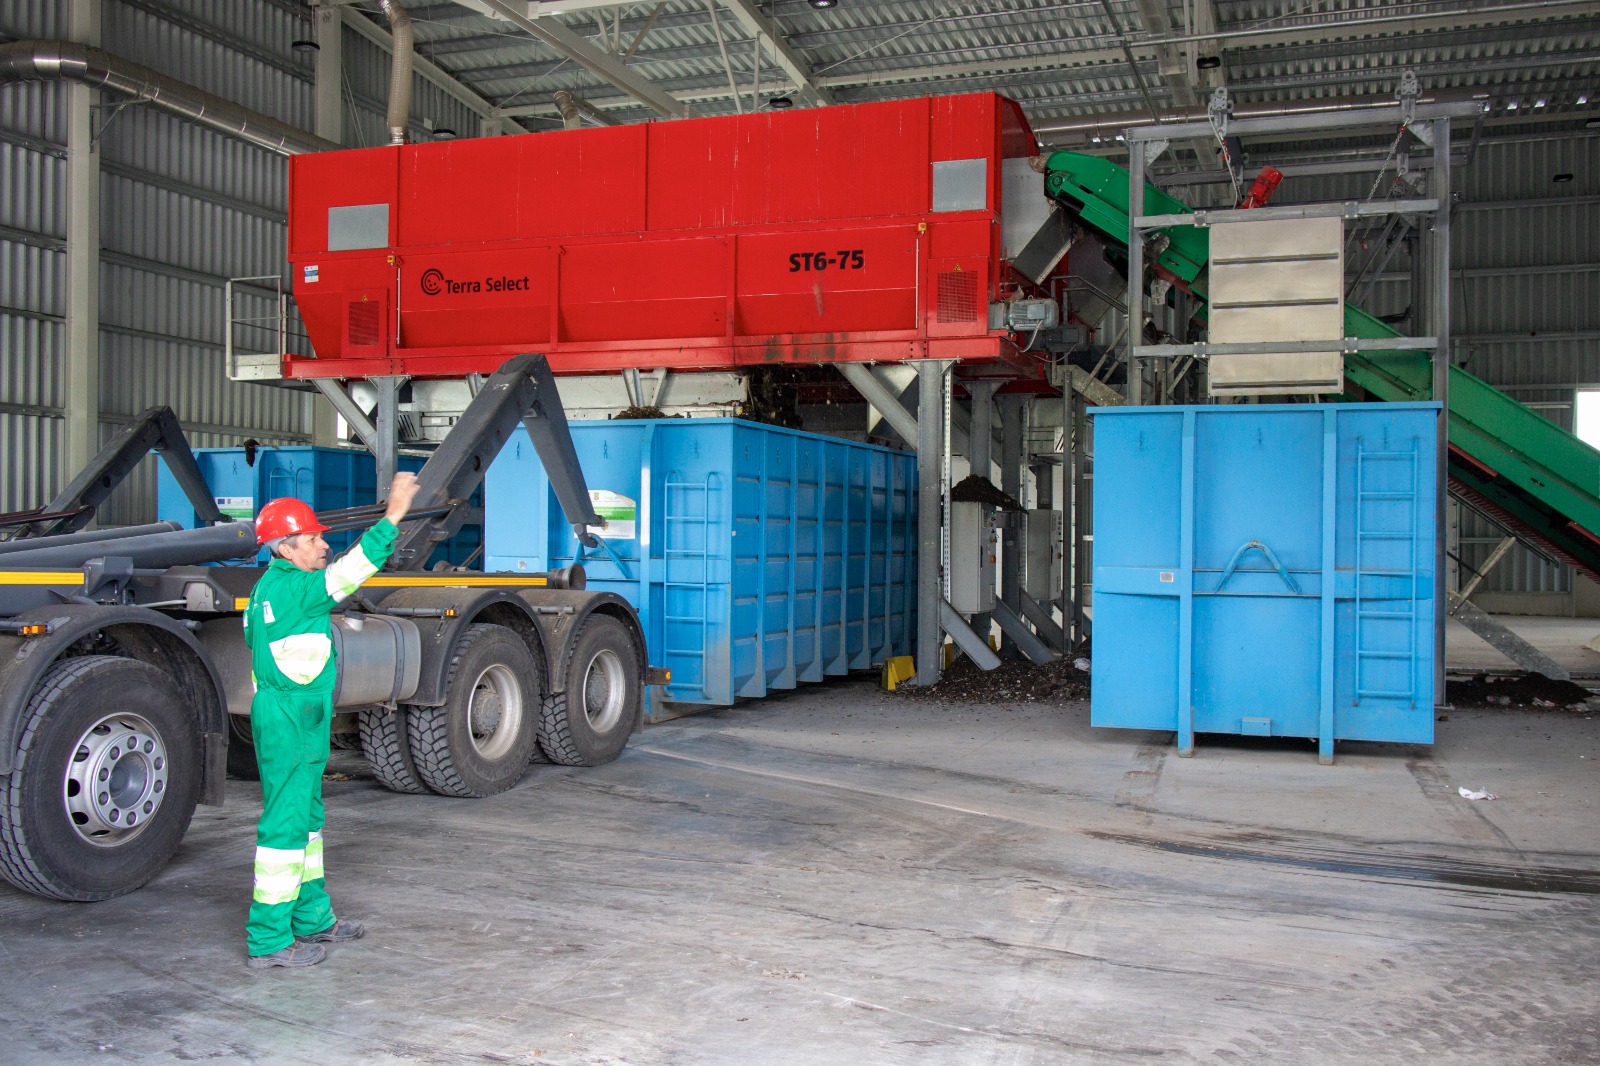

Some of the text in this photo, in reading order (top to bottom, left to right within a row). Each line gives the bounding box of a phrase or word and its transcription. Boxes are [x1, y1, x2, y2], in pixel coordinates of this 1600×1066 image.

[789, 250, 865, 272] ST6-75
[445, 276, 530, 294] Terra Select
